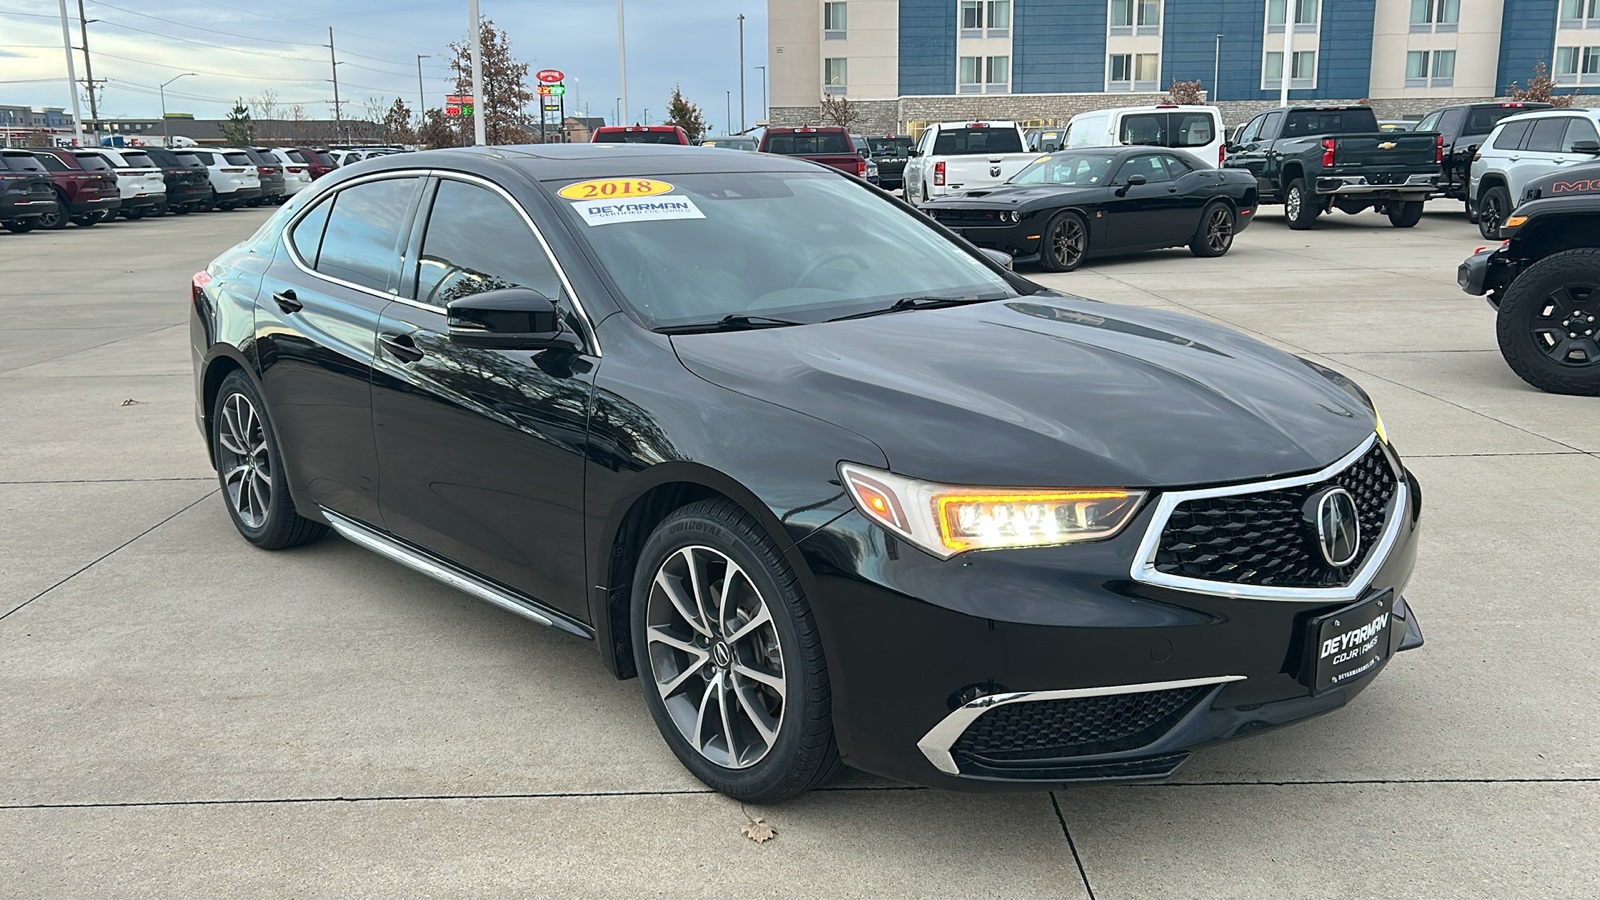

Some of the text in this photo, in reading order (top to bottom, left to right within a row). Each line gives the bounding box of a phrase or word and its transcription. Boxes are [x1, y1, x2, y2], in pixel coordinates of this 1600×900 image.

[56, 138, 78, 148] FedE
[582, 181, 652, 198] 2018
[588, 202, 689, 215] DEYARMAN
[599, 210, 643, 218] CERTIFIED
[669, 521, 722, 537] UNIROYAL
[1320, 612, 1389, 659] DEYARMAN
[1362, 635, 1379, 654] AMES
